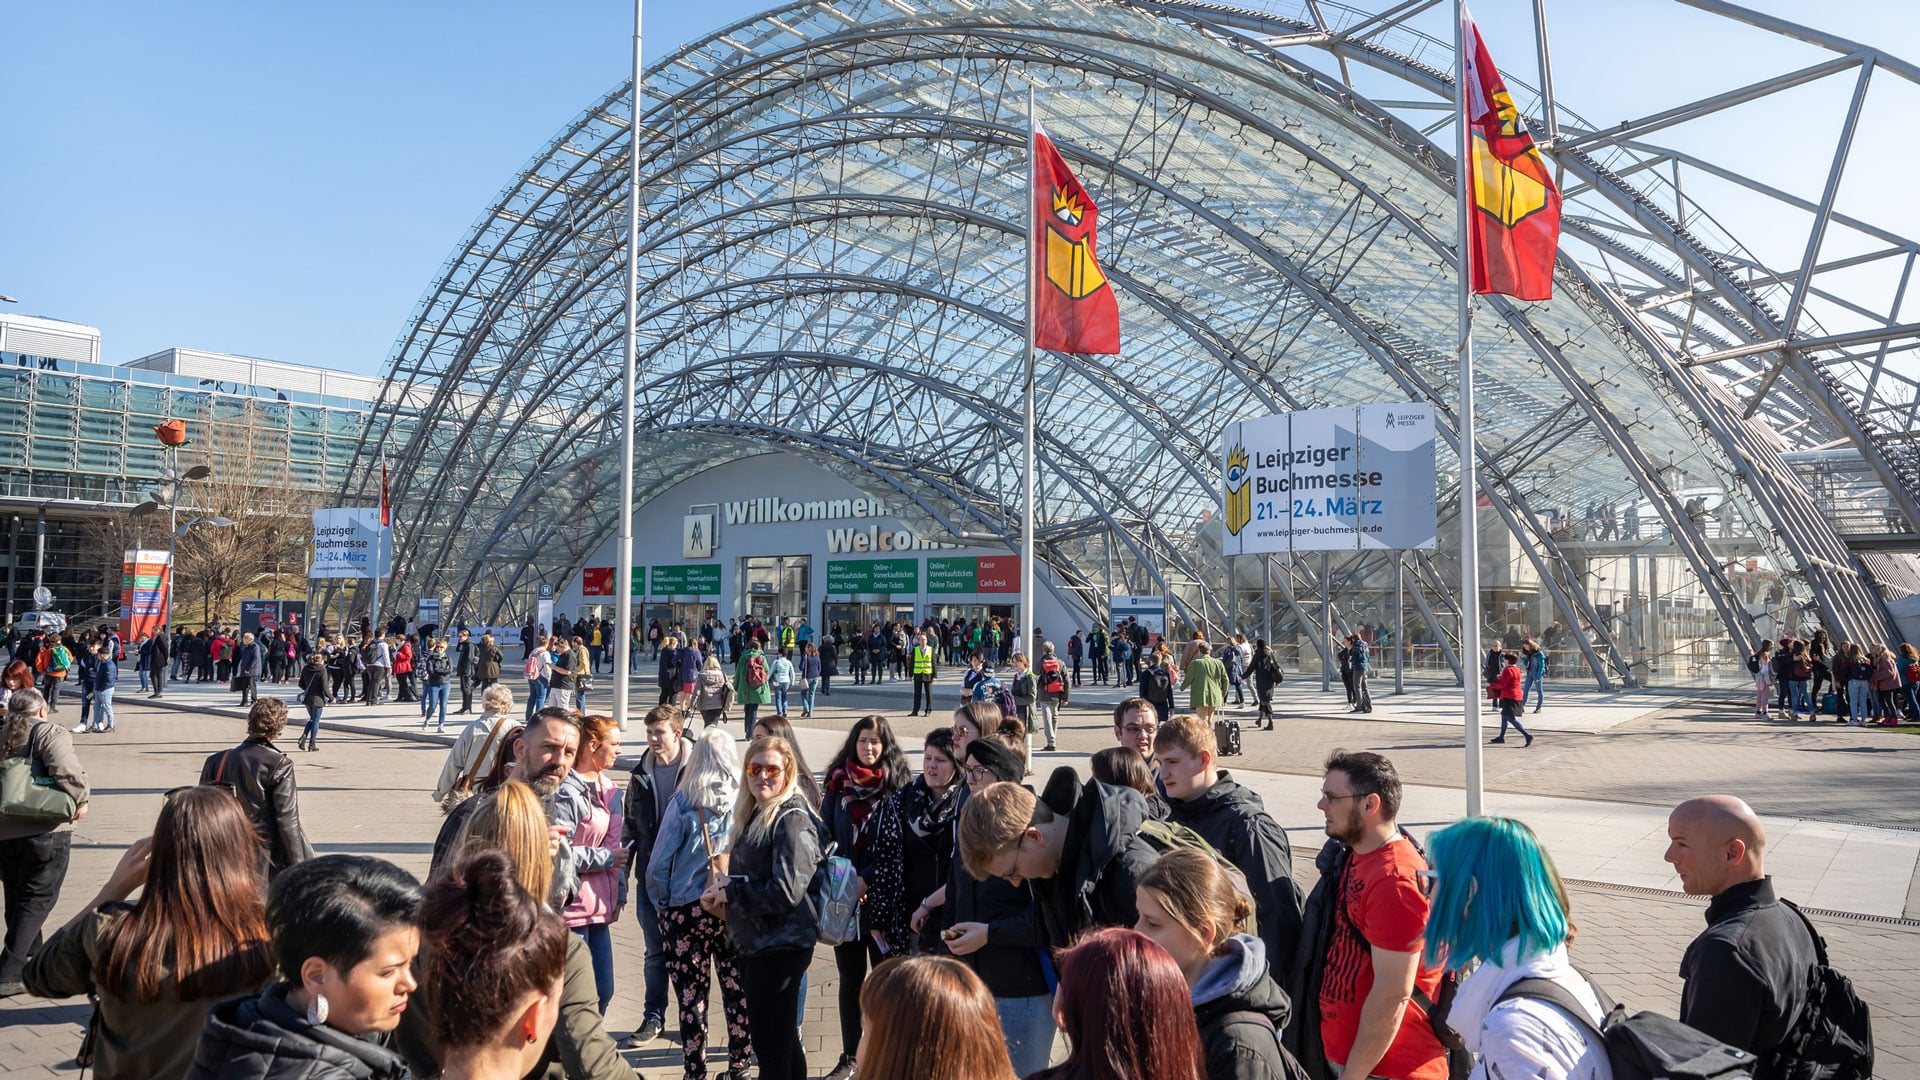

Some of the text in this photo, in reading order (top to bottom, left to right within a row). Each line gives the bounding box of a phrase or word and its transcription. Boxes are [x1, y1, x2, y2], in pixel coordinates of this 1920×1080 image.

[1256, 445, 1351, 471] Leipziger
[1256, 471, 1382, 494] Buchmesse
[1326, 497, 1382, 517] März
[316, 525, 356, 537] Leipziger
[1257, 525, 1383, 537] www.leipziger-buchmesse.de
[316, 539, 368, 549] Buchmesse
[343, 551, 367, 562] März
[930, 570, 973, 578] Vorverkaufstickets
[873, 581, 888, 589] Online
[930, 580, 963, 588] Online Tickets
